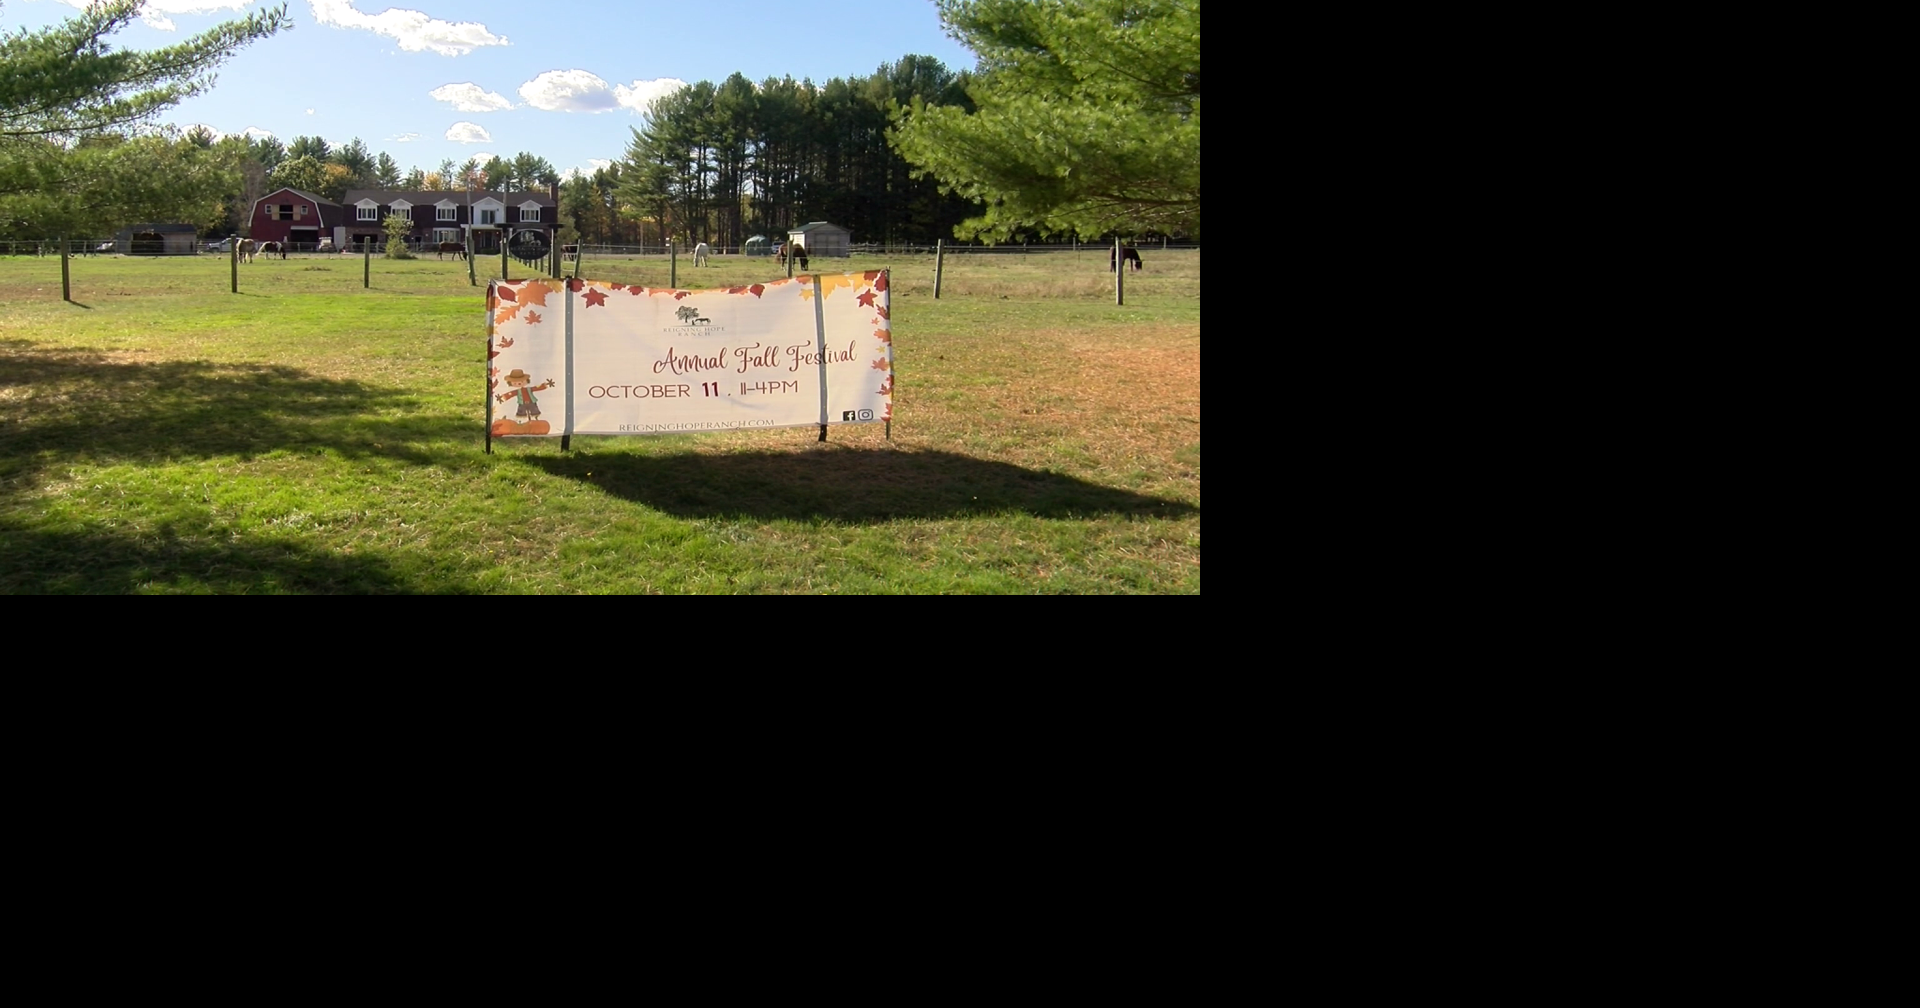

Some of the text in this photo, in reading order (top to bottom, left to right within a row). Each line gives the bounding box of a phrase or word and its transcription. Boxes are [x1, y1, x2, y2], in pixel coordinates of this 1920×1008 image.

[653, 340, 857, 376] Annual Fall Festival
[588, 384, 691, 399] OCTOBER
[702, 381, 719, 398] 11
[619, 419, 775, 432] REIGNINGHOPERANCH.COM
